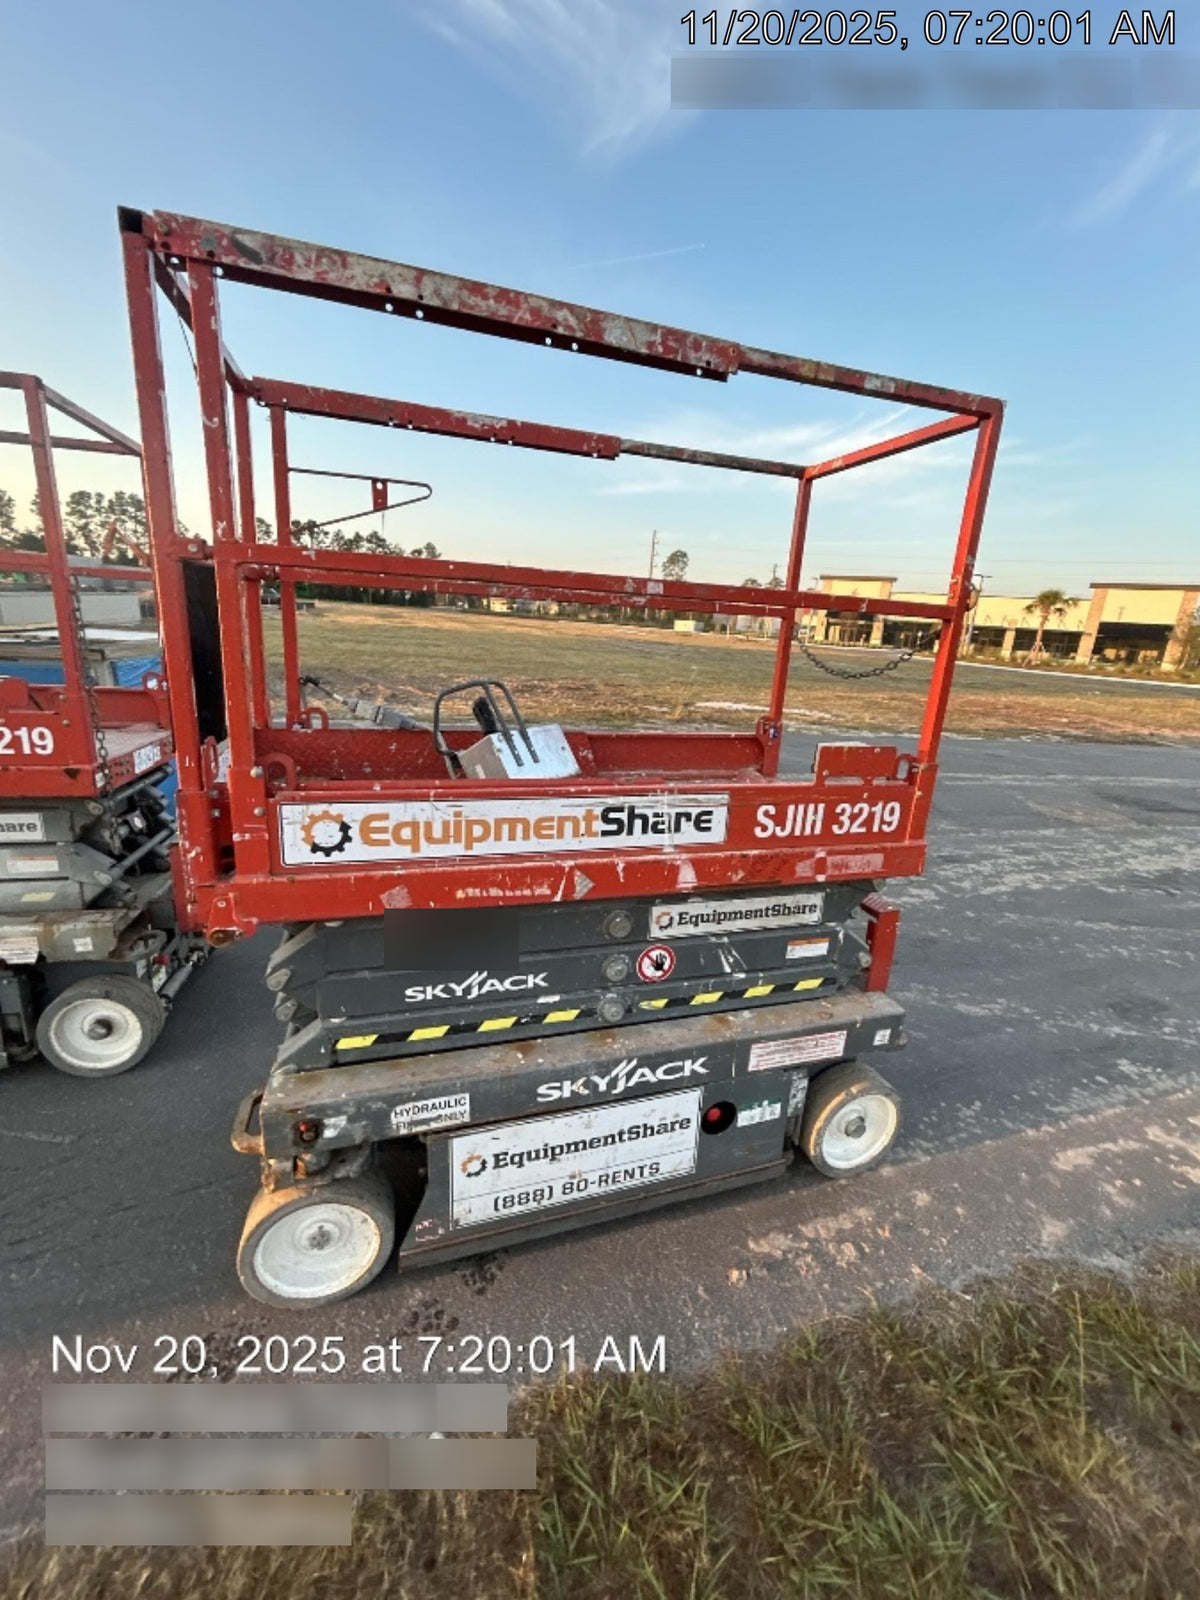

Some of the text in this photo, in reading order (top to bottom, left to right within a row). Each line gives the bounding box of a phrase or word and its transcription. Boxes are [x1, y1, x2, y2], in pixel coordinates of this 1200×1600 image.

[358, 806, 713, 853] EquipmentShare
[831, 801, 901, 835] 3219
[677, 902, 818, 927] EquipmentShare
[405, 970, 548, 1002] SKYJACK
[536, 1057, 709, 1102] SKYJACK
[394, 1097, 467, 1119] HYDRAULIC
[492, 1117, 691, 1170] EquipmentShare
[493, 1162, 661, 1212] (888) 80-RENTS
